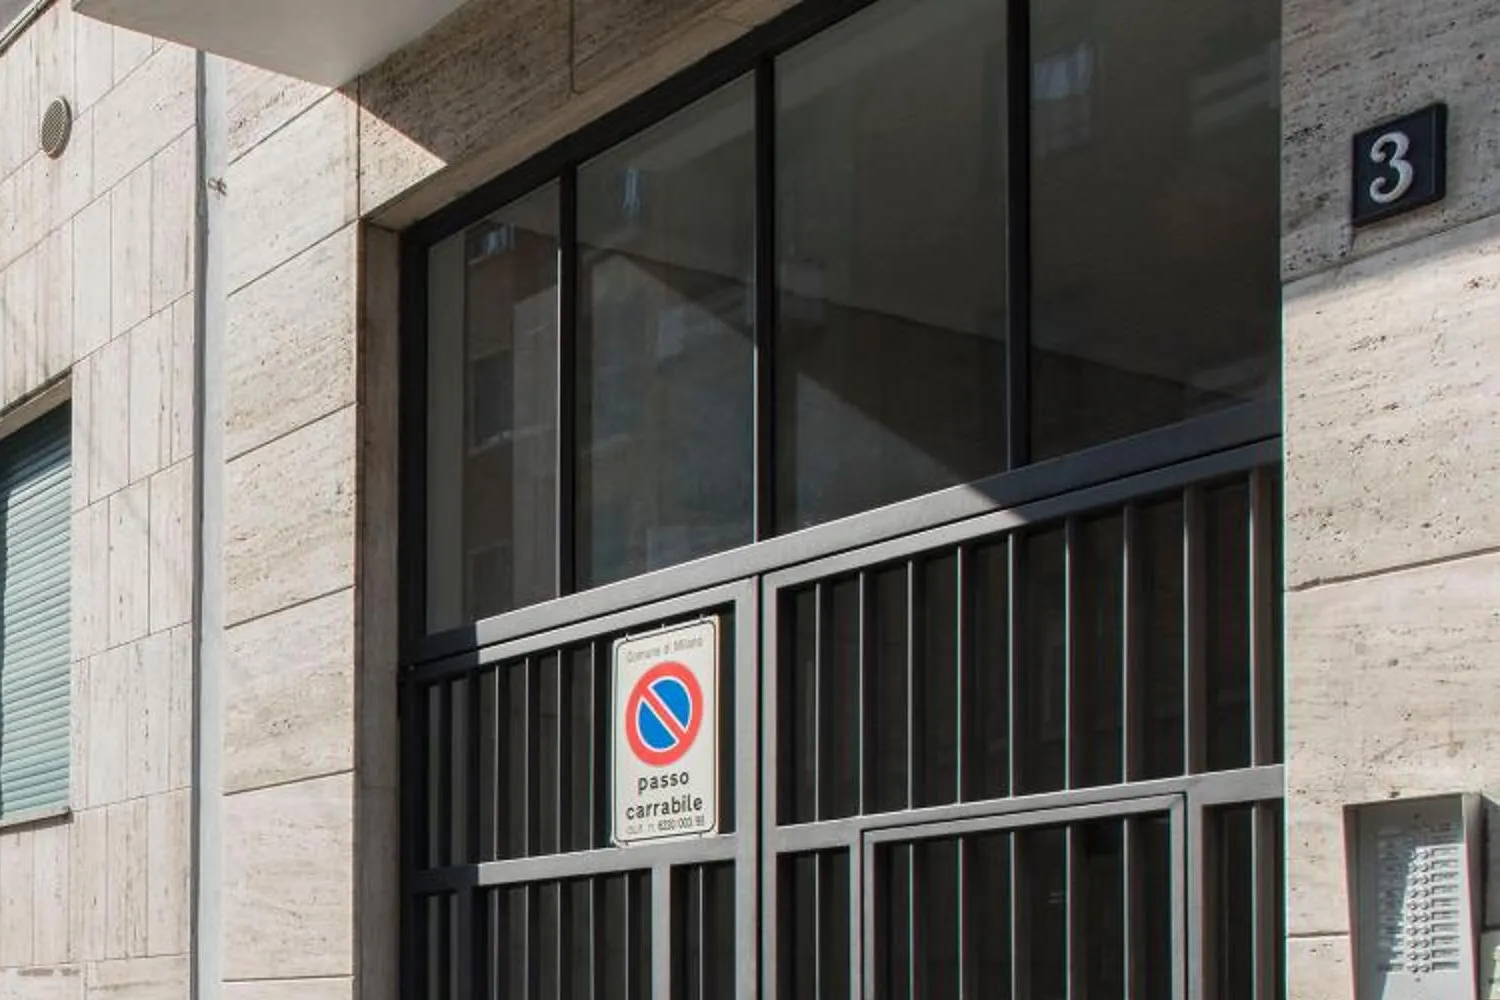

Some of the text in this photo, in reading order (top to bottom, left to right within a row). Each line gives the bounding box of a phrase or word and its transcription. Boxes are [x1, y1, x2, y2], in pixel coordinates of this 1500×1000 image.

[1369, 131, 1414, 204] 3
[638, 771, 689, 795] passo
[626, 793, 703, 820] carrabile
